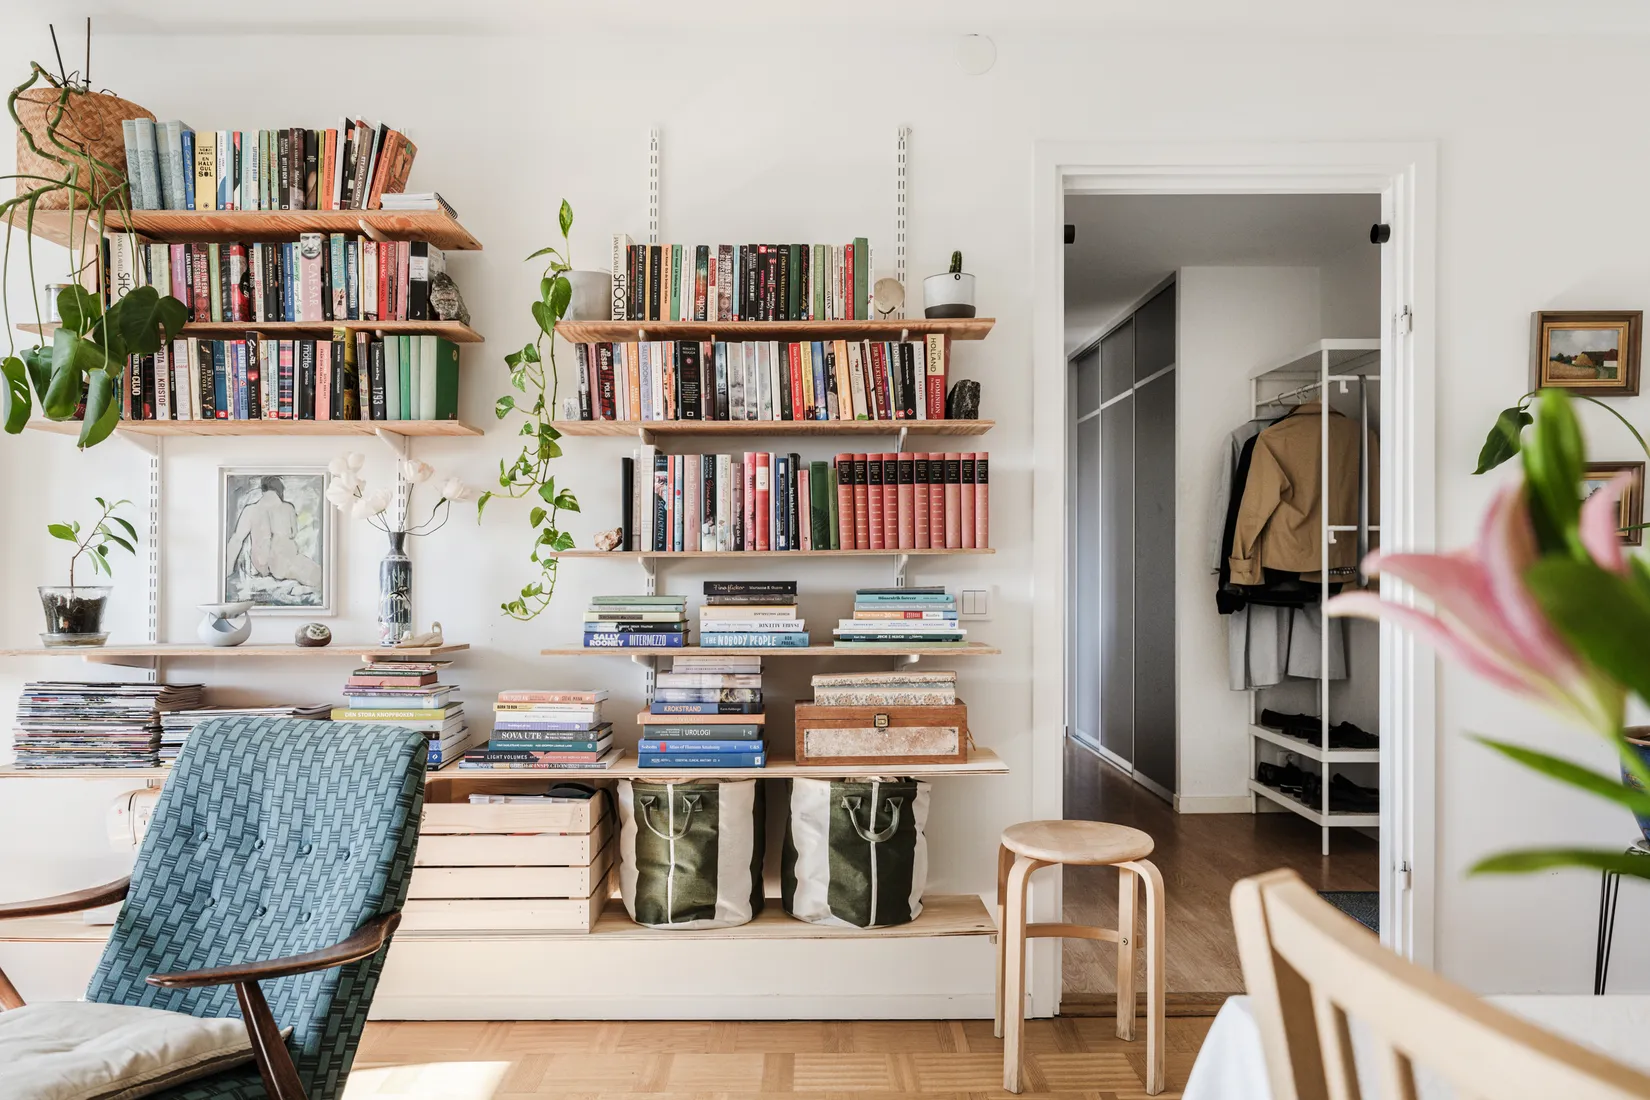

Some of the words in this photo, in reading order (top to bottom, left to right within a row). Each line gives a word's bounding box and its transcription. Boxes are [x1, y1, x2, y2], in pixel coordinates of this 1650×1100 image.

[308, 263, 318, 307] CAESAR
[613, 274, 625, 321] SHOGUN
[600, 348, 608, 371] NESBØ
[131, 376, 141, 396] CUJO
[158, 378, 166, 407] KRISTOF
[372, 387, 384, 405] 1793
[629, 634, 667, 646] INTERMEZZO
[717, 634, 748, 646] NOBODY
[749, 634, 777, 646] PEOPLE
